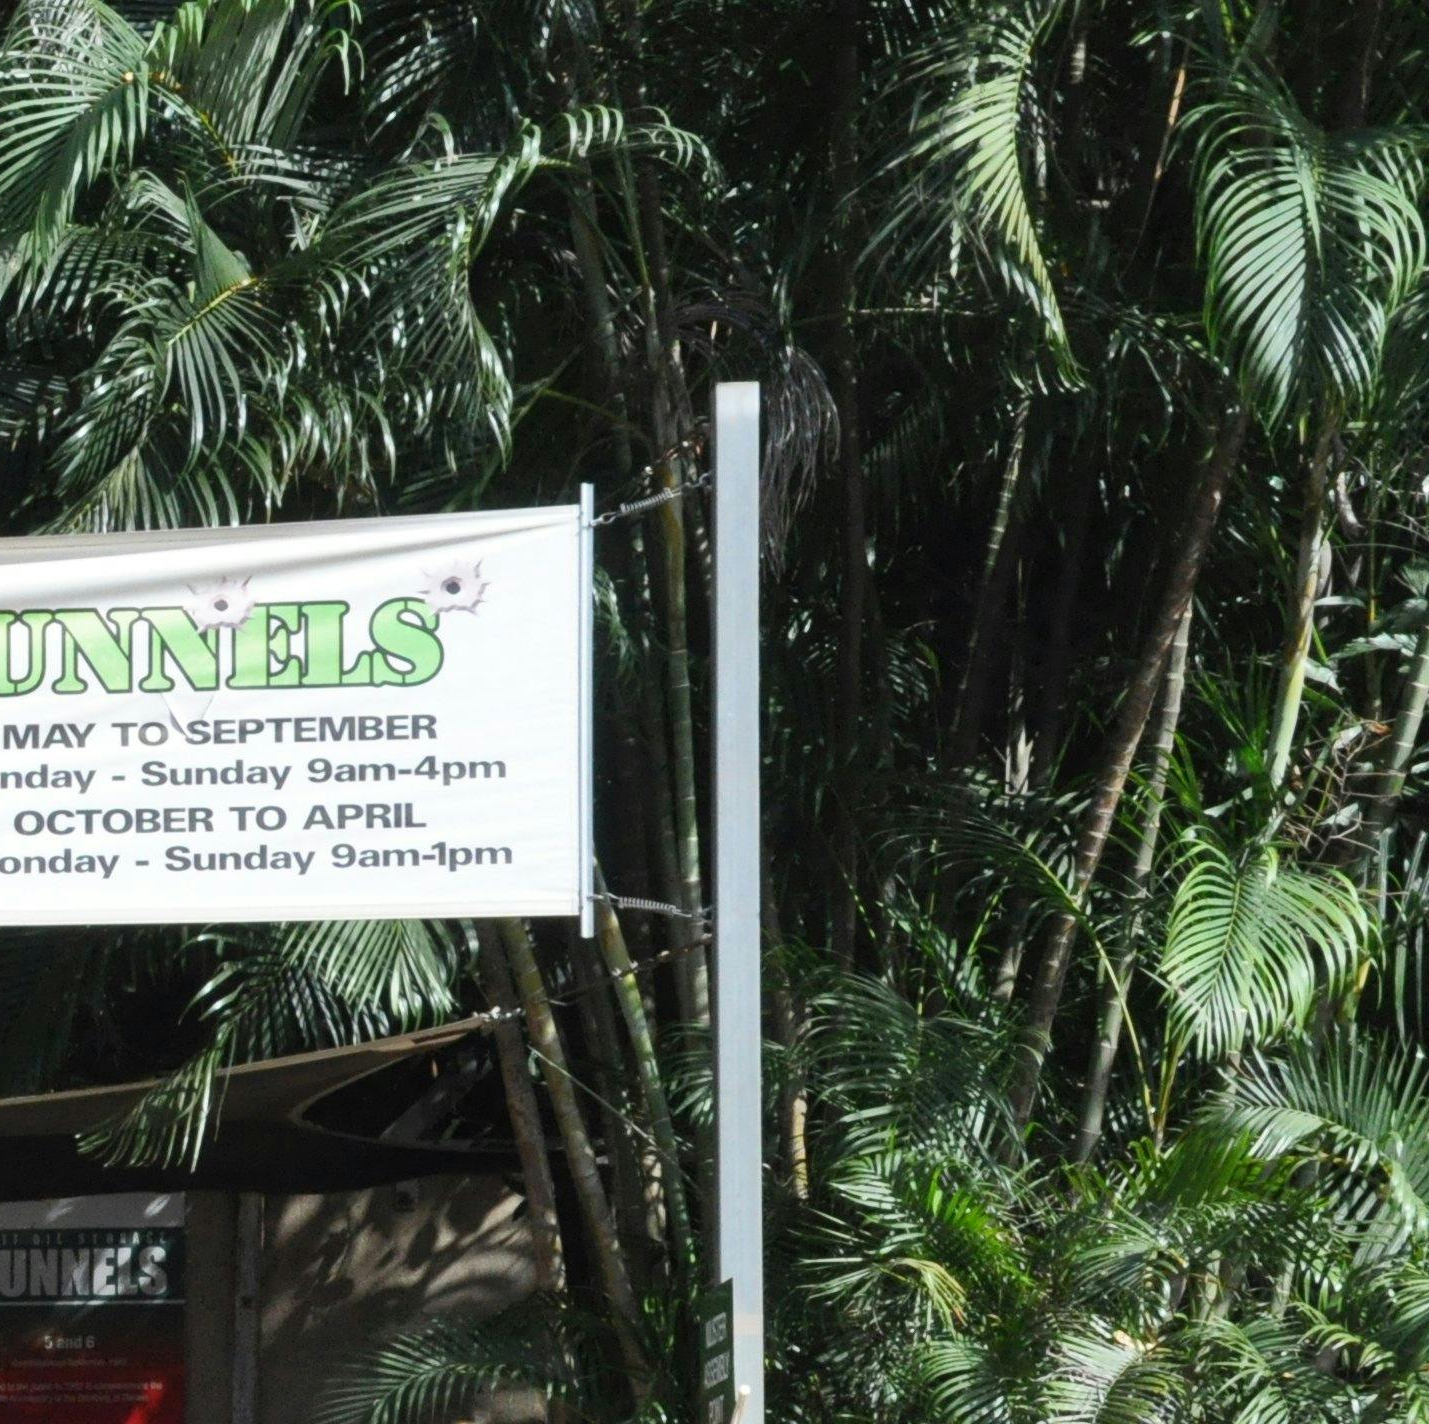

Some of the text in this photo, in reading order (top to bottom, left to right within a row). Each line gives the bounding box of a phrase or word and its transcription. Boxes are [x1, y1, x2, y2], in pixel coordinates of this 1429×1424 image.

[2, 714, 438, 750] MAY TO SEPTEMBER
[140, 759, 292, 790] Sunday
[306, 755, 507, 786] 9am-4pm
[13, 803, 427, 836] OCTOBER TO APRIL
[164, 844, 315, 875] Sunday
[330, 840, 513, 871] 9am-1pm
